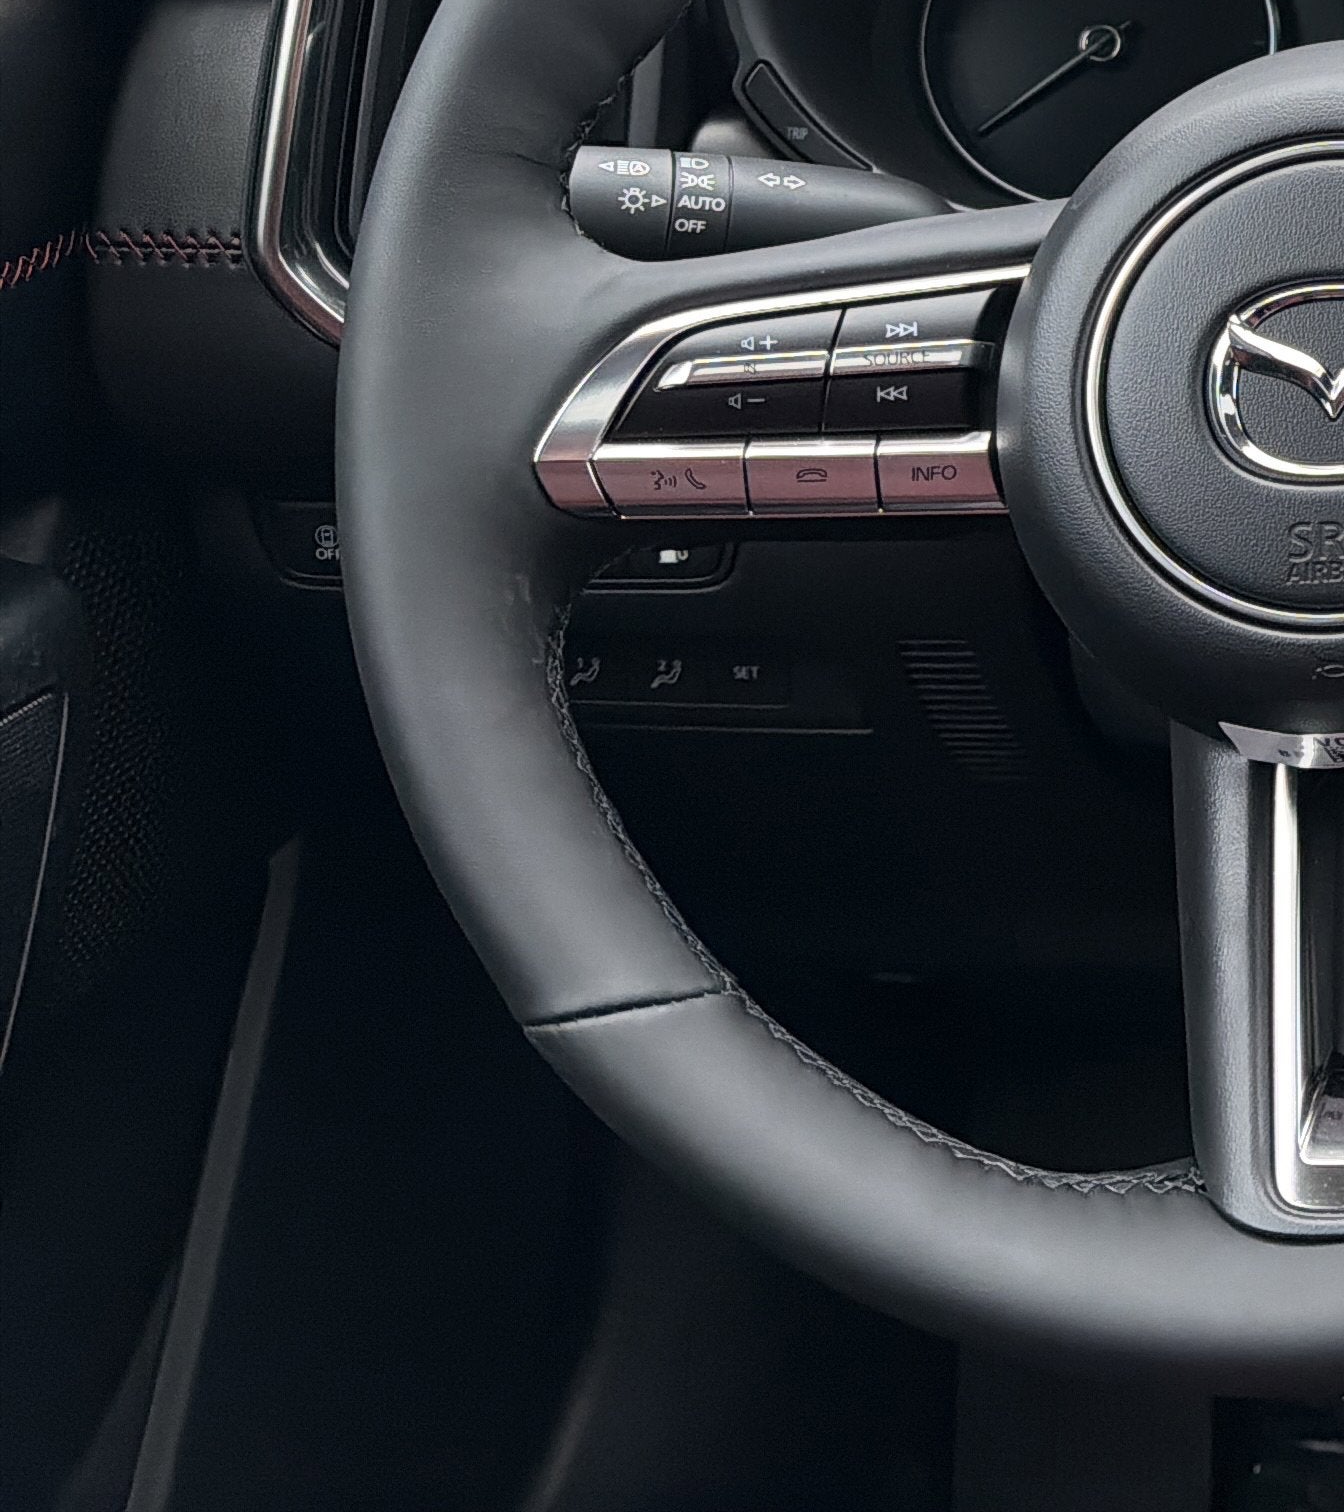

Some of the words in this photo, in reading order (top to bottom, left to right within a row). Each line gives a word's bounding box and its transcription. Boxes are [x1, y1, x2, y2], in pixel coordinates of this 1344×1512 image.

[786, 126, 809, 140] TRIP
[677, 195, 726, 212] AUTO
[674, 219, 707, 234] OFF
[861, 348, 931, 367] SOURCE
[910, 464, 957, 482] INFO
[732, 665, 760, 680] SET
